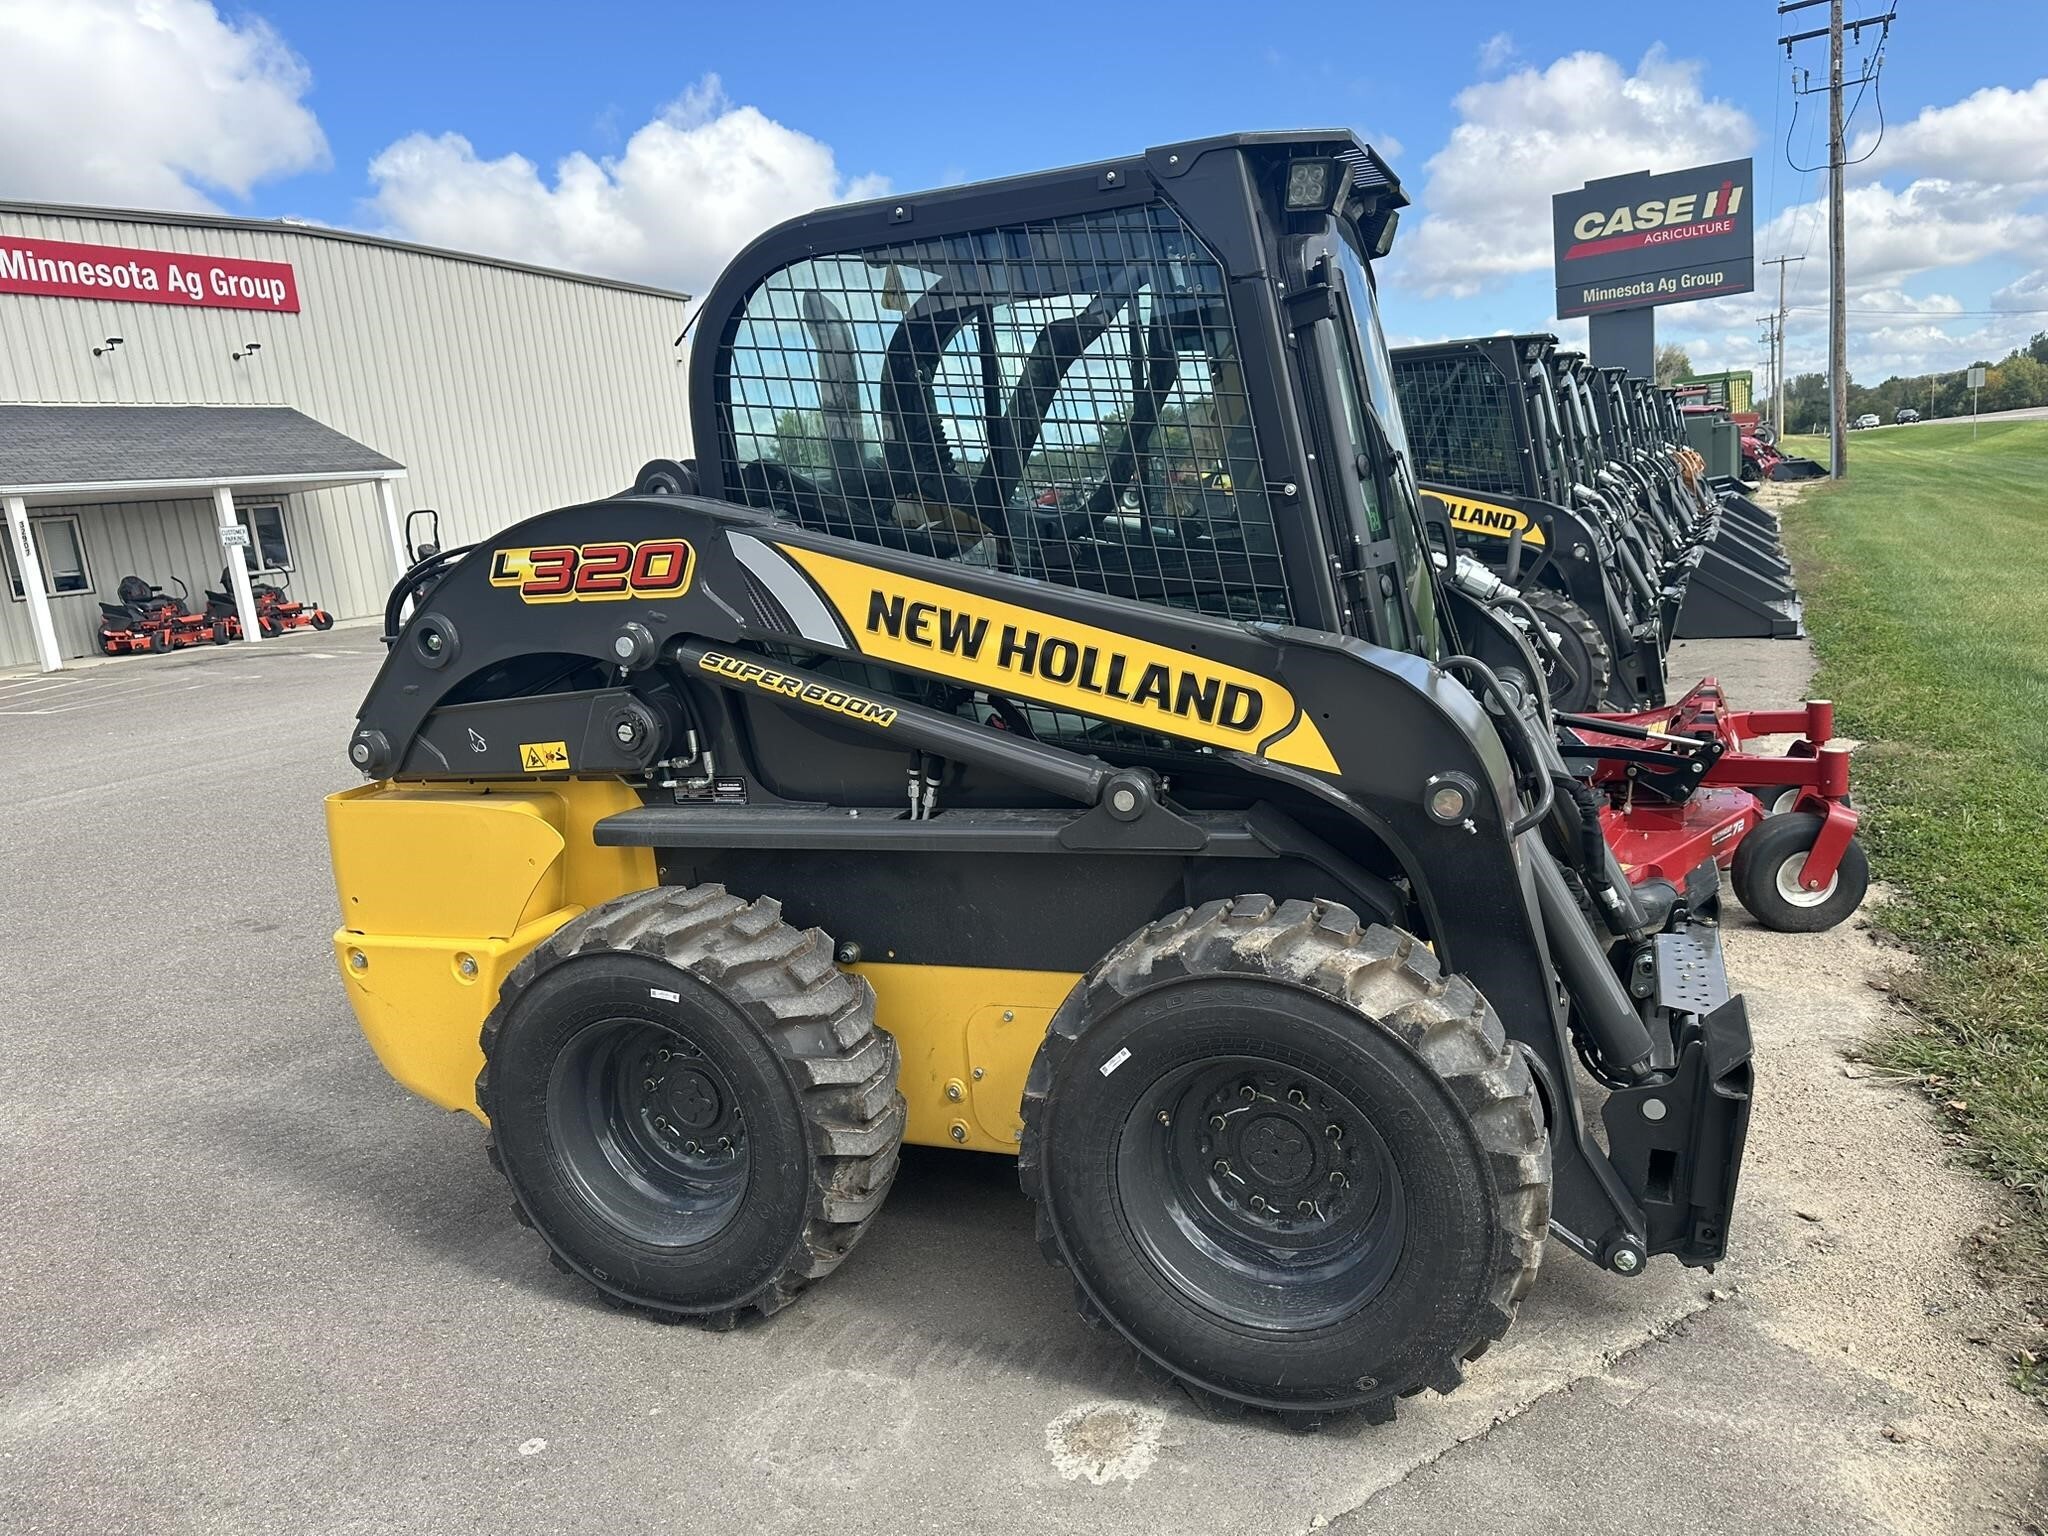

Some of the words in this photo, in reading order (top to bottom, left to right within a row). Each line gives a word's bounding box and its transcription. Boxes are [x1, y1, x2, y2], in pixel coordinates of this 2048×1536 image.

[1574, 195, 1697, 241] CASE
[1644, 220, 1731, 244] AGRICULTURE
[0, 248, 160, 292] Minnesota
[168, 264, 204, 301] Ag
[210, 267, 286, 305] Group
[1583, 281, 1655, 303] Minnesota
[1658, 277, 1677, 293] Ag
[1681, 271, 1724, 288] Group
[1446, 502, 1517, 531] LLAND
[489, 538, 697, 604] L320
[865, 588, 990, 661] NEW
[997, 623, 1264, 733] HOLLAND
[700, 651, 803, 697] SUPER
[801, 683, 898, 728] BOOM
